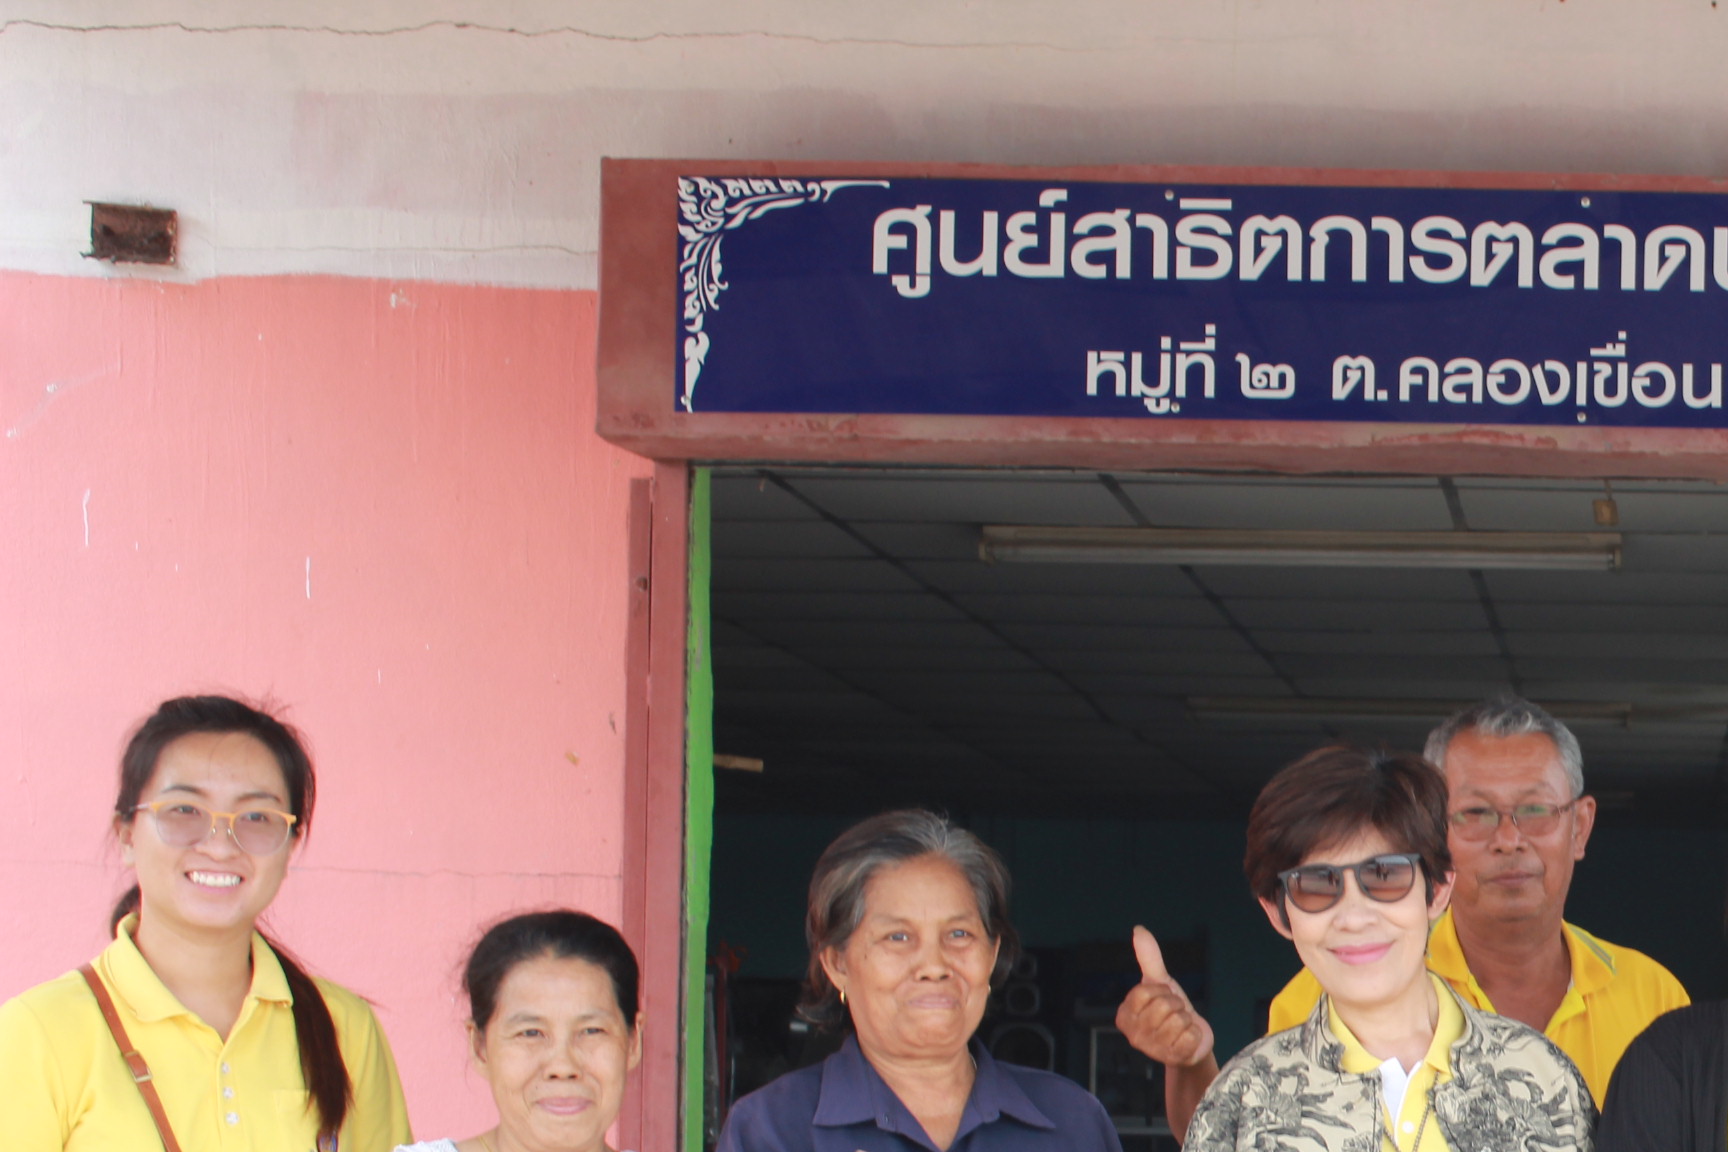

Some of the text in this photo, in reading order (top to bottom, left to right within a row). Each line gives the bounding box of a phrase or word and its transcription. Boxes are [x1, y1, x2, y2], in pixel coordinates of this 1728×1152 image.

[1087, 324, 1215, 414] หมู่ที่
[1235, 353, 1295, 398] ๒
[1332, 331, 1721, 408] ต.คลองเขื่อน
